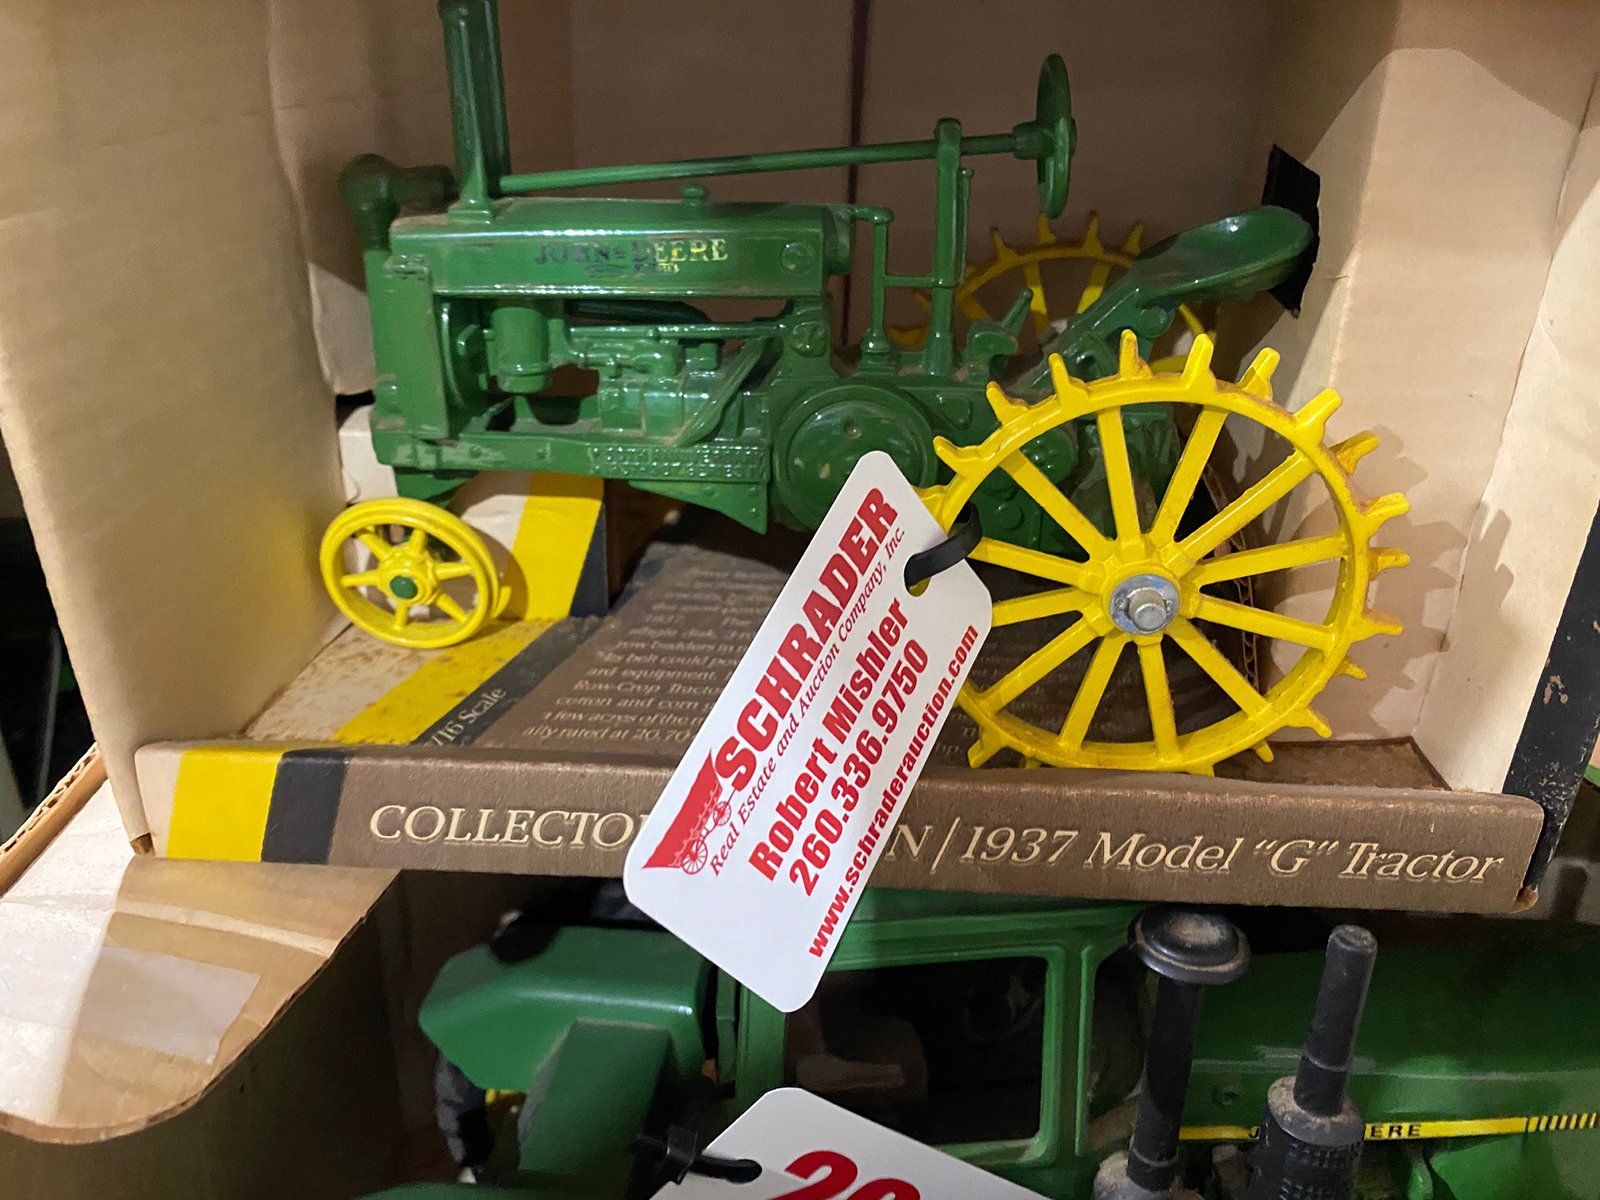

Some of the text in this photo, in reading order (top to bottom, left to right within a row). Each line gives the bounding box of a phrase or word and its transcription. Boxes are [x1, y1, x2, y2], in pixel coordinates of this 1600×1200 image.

[458, 688, 507, 724] Scale
[709, 527, 906, 877] Real Estate and Auction Company, Inc.
[713, 487, 900, 792] SCHRADER
[748, 597, 909, 882] Robert Mishler
[788, 639, 929, 897] 260.336.9750
[808, 624, 979, 958] www.schraderauction.com
[1085, 831, 1245, 872] Model
[1340, 841, 1505, 881] Tractor
[1368, 1122, 1422, 1138] ERE
